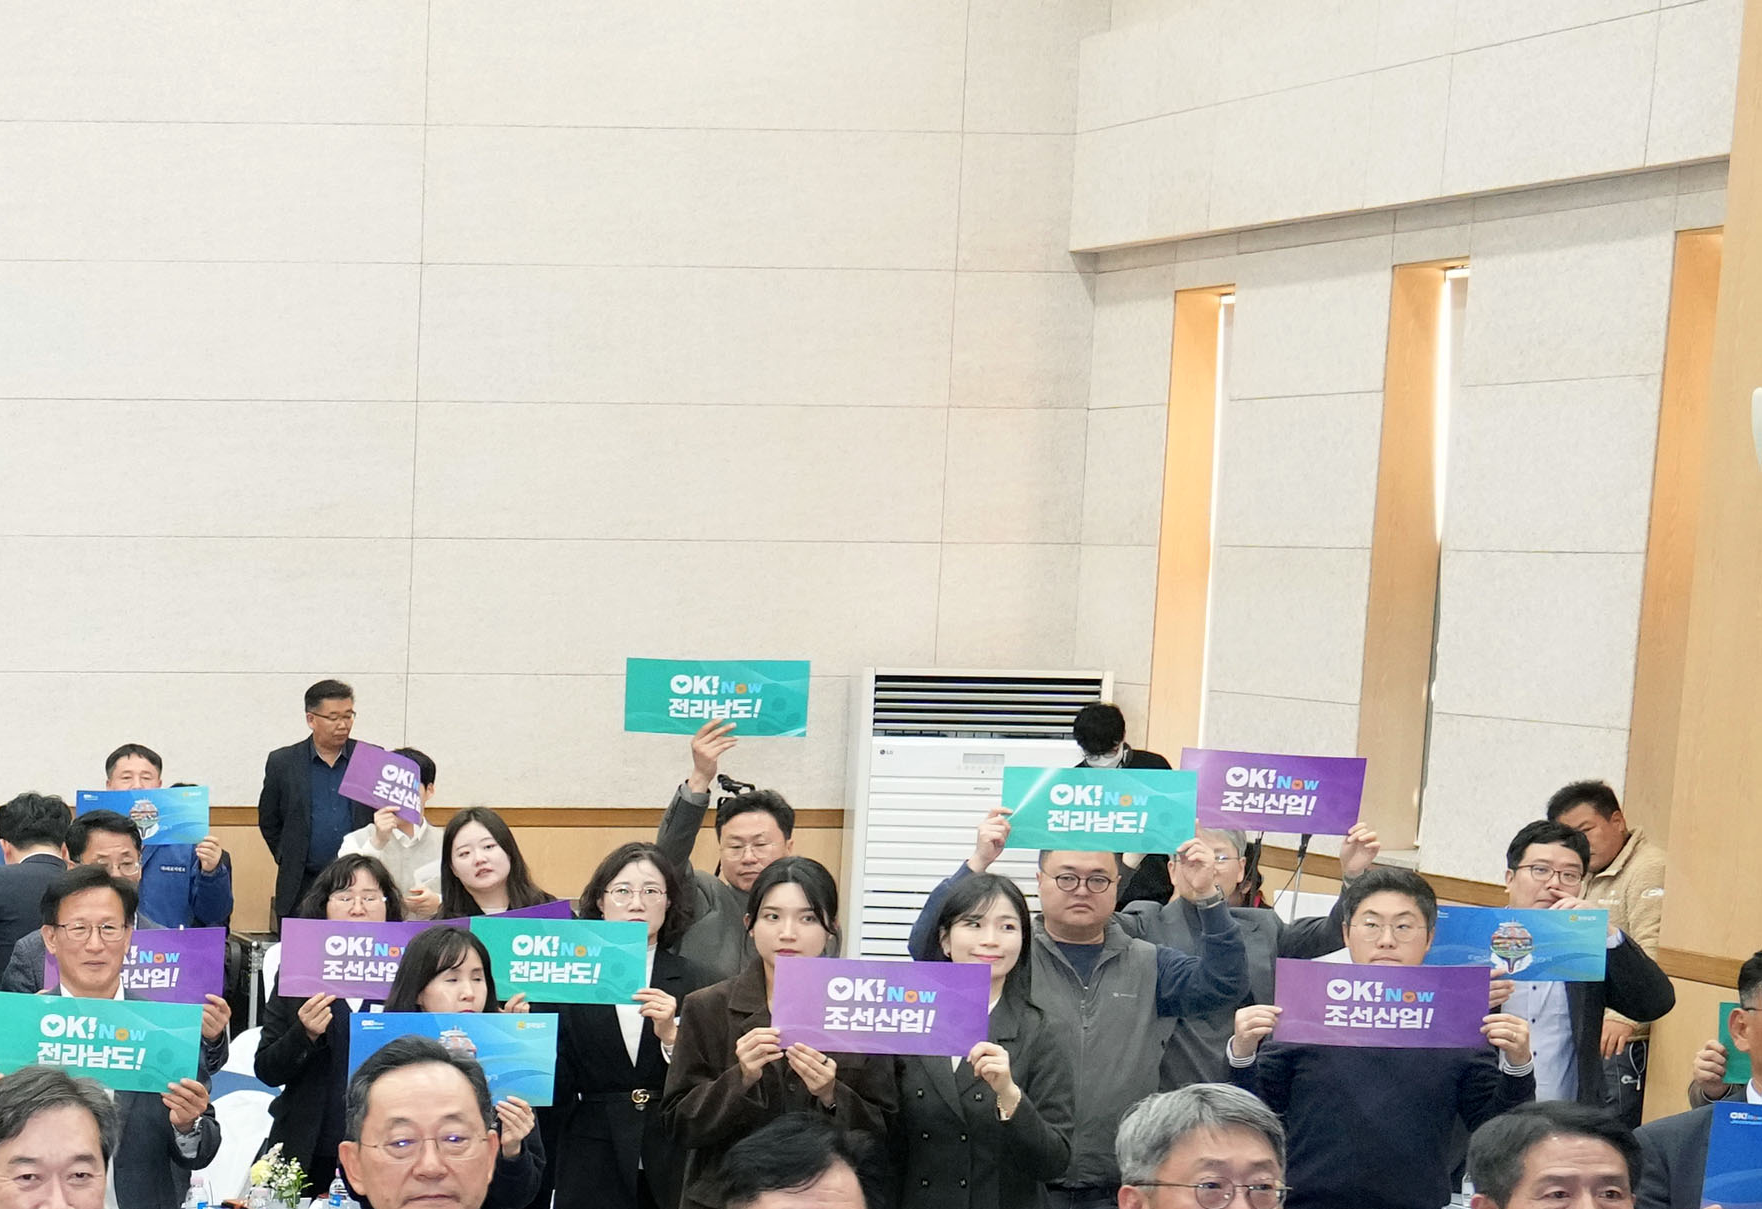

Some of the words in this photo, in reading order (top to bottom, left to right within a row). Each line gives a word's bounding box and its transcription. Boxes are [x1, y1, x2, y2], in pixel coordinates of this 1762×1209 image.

[670, 675, 720, 694] OK!
[668, 698, 762, 719] 전라남도!
[382, 764, 414, 788] OK!
[1226, 766, 1276, 789] OK!
[1050, 784, 1103, 806] OK!
[1221, 791, 1316, 816] 조선산업!
[1047, 809, 1147, 834] 전라남도!
[325, 935, 373, 958] OK!
[512, 934, 559, 957] OK!
[509, 960, 602, 985] 전라남도!
[828, 977, 886, 1002] OK!
[1326, 978, 1383, 1001] OK!
[40, 1013, 96, 1039] OK!
[824, 1007, 935, 1033] 조선산업!
[1324, 1004, 1435, 1029] 조선산업!
[37, 1042, 146, 1070] 전라남도!
